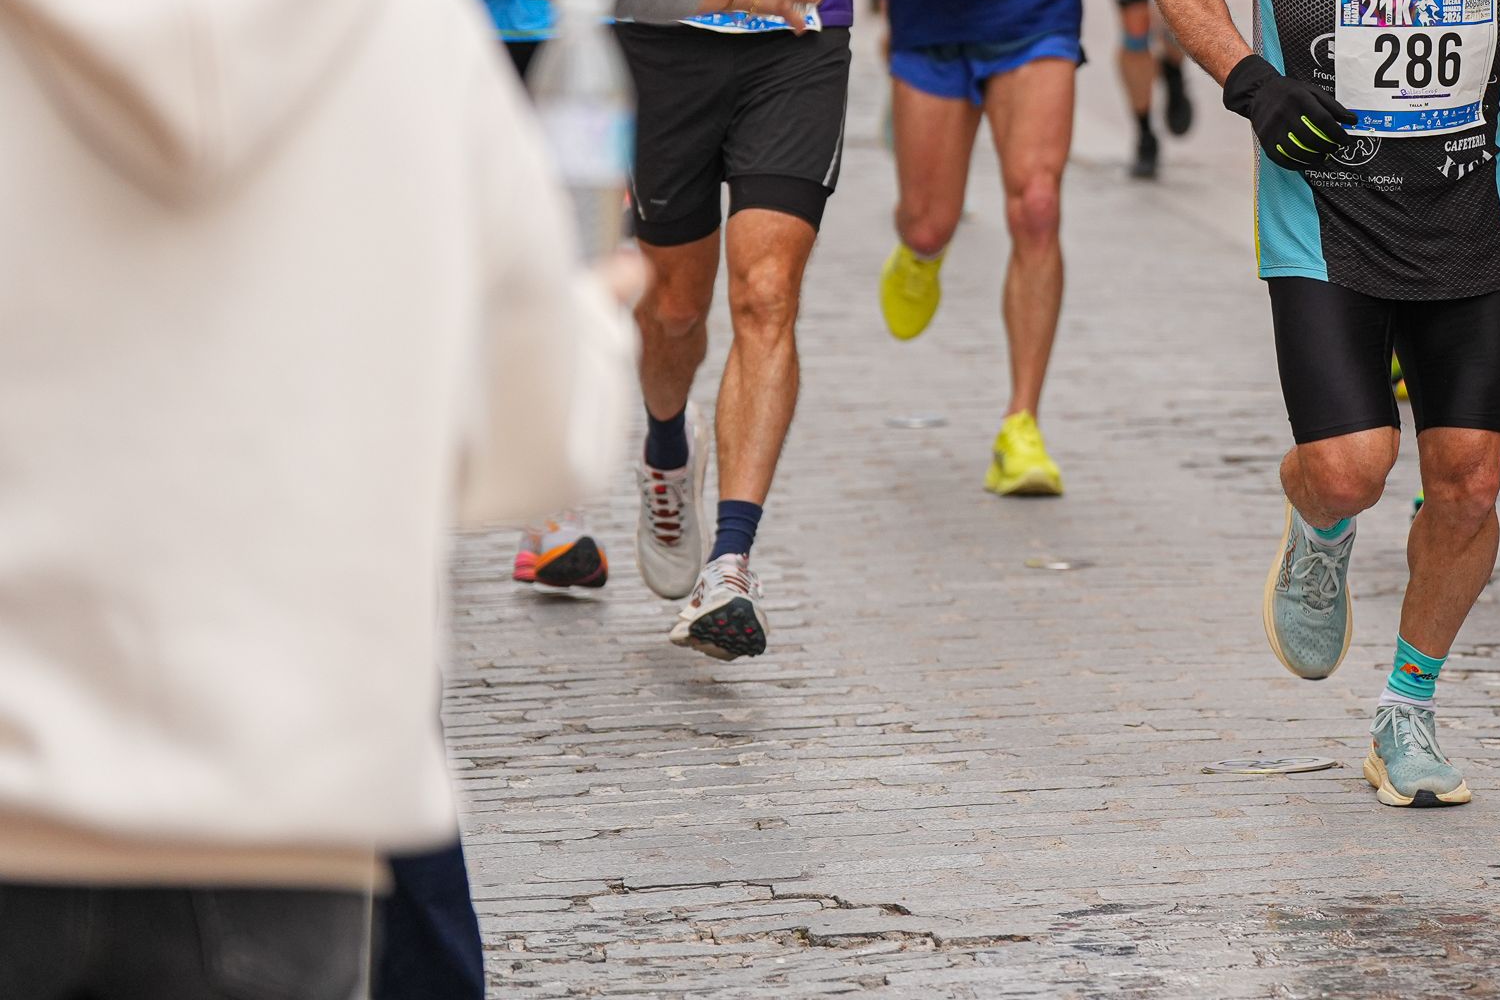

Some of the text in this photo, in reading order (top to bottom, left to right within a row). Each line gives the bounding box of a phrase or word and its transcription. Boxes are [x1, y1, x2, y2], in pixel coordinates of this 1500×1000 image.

[1443, 12, 1461, 23] 2026
[1374, 32, 1463, 88] 286
[1444, 133, 1487, 152] CAFETERIA
[1305, 169, 1359, 180] FRANCISCO
[1368, 173, 1403, 184] MORÁN
